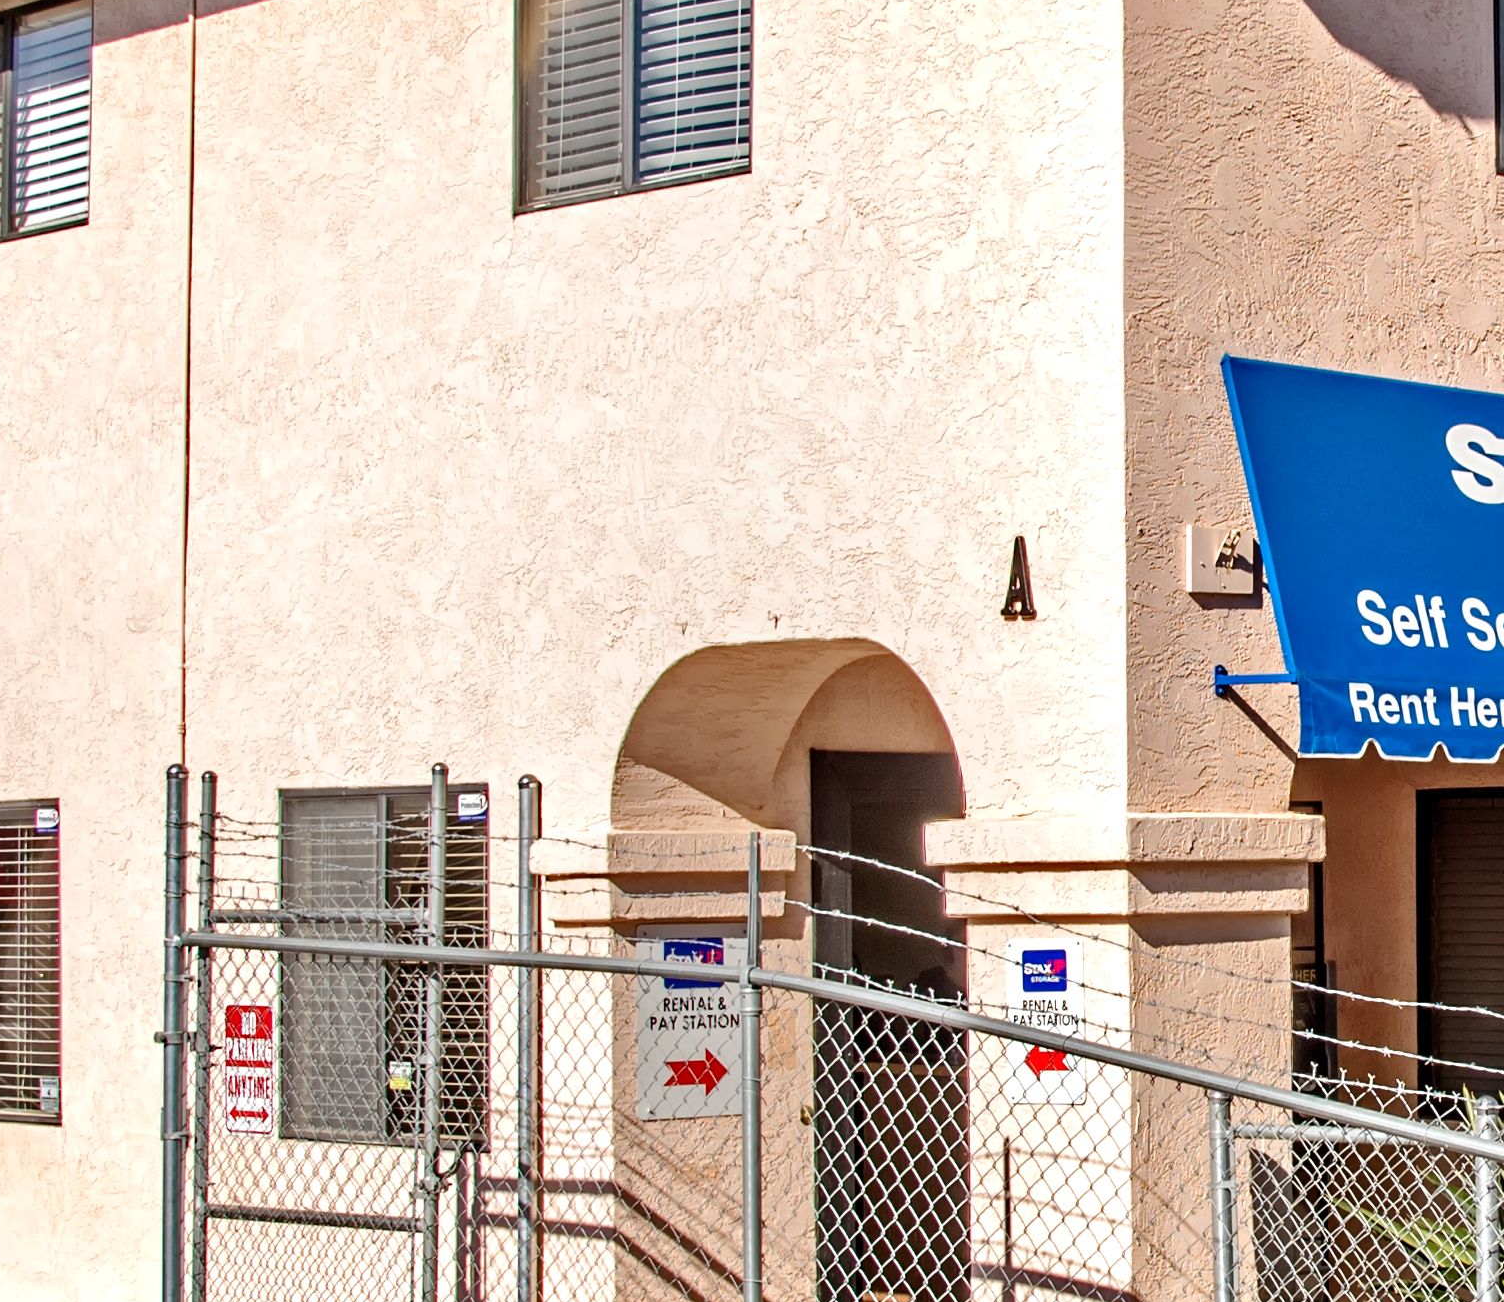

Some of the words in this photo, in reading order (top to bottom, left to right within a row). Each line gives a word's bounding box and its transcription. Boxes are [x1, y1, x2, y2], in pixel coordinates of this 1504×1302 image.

[1001, 535, 1037, 621] A
[1356, 589, 1449, 648] Self
[1348, 682, 1440, 726] Rent
[663, 997, 713, 1012] RENTAL
[718, 997, 727, 1010] &
[1022, 1000, 1058, 1011] RENTAL
[1062, 1000, 1068, 1011] &
[241, 1011, 257, 1036] NO
[650, 1016, 677, 1031] PAY
[682, 1014, 740, 1030] STATION
[1013, 1015, 1033, 1025] PAY
[1037, 1014, 1079, 1026] STATION
[226, 1037, 272, 1062] PARKING
[228, 1074, 270, 1098] ANYTIME
